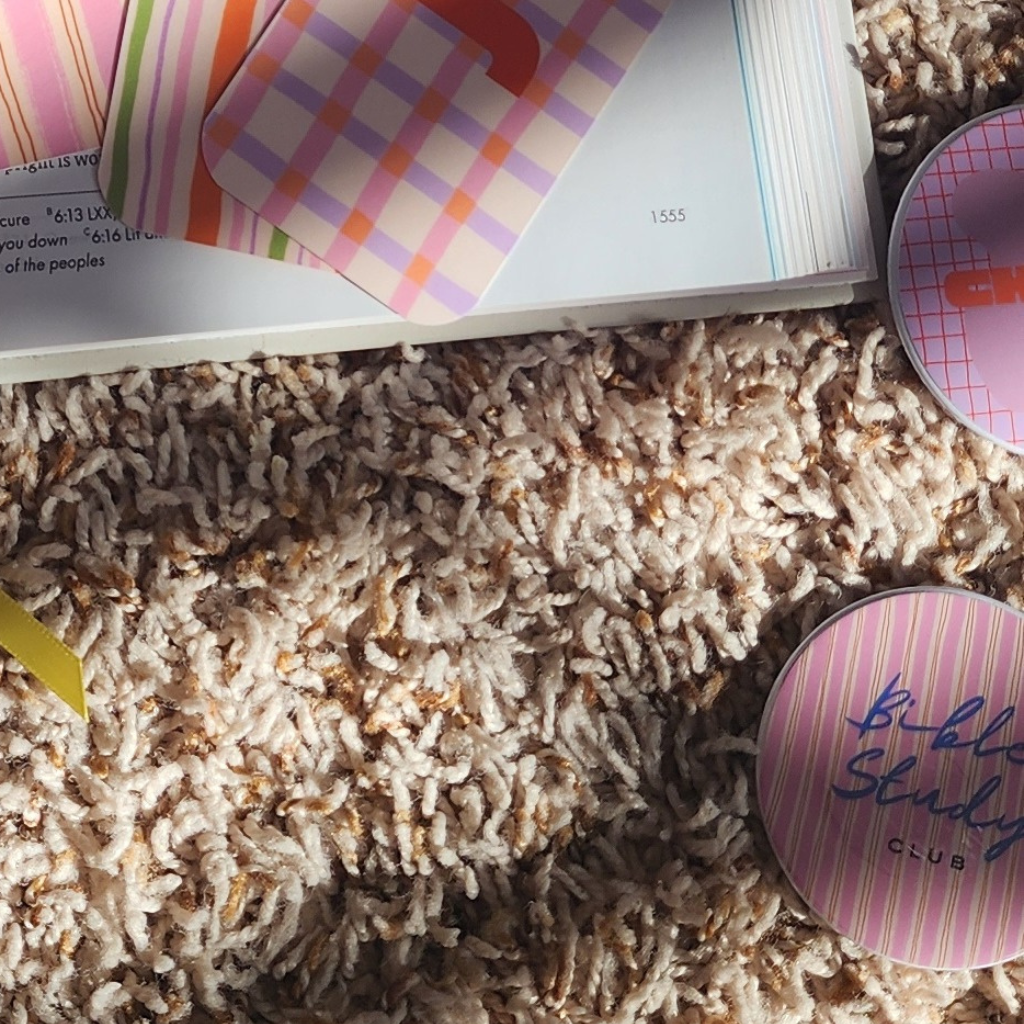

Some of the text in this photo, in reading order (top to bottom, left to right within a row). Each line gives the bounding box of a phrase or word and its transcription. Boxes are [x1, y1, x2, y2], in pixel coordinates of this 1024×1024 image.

[650, 208, 686, 223] 1555
[28, 233, 68, 248] down
[24, 257, 45, 272] the
[50, 254, 105, 273] peoples
[887, 837, 965, 871] CLUB
